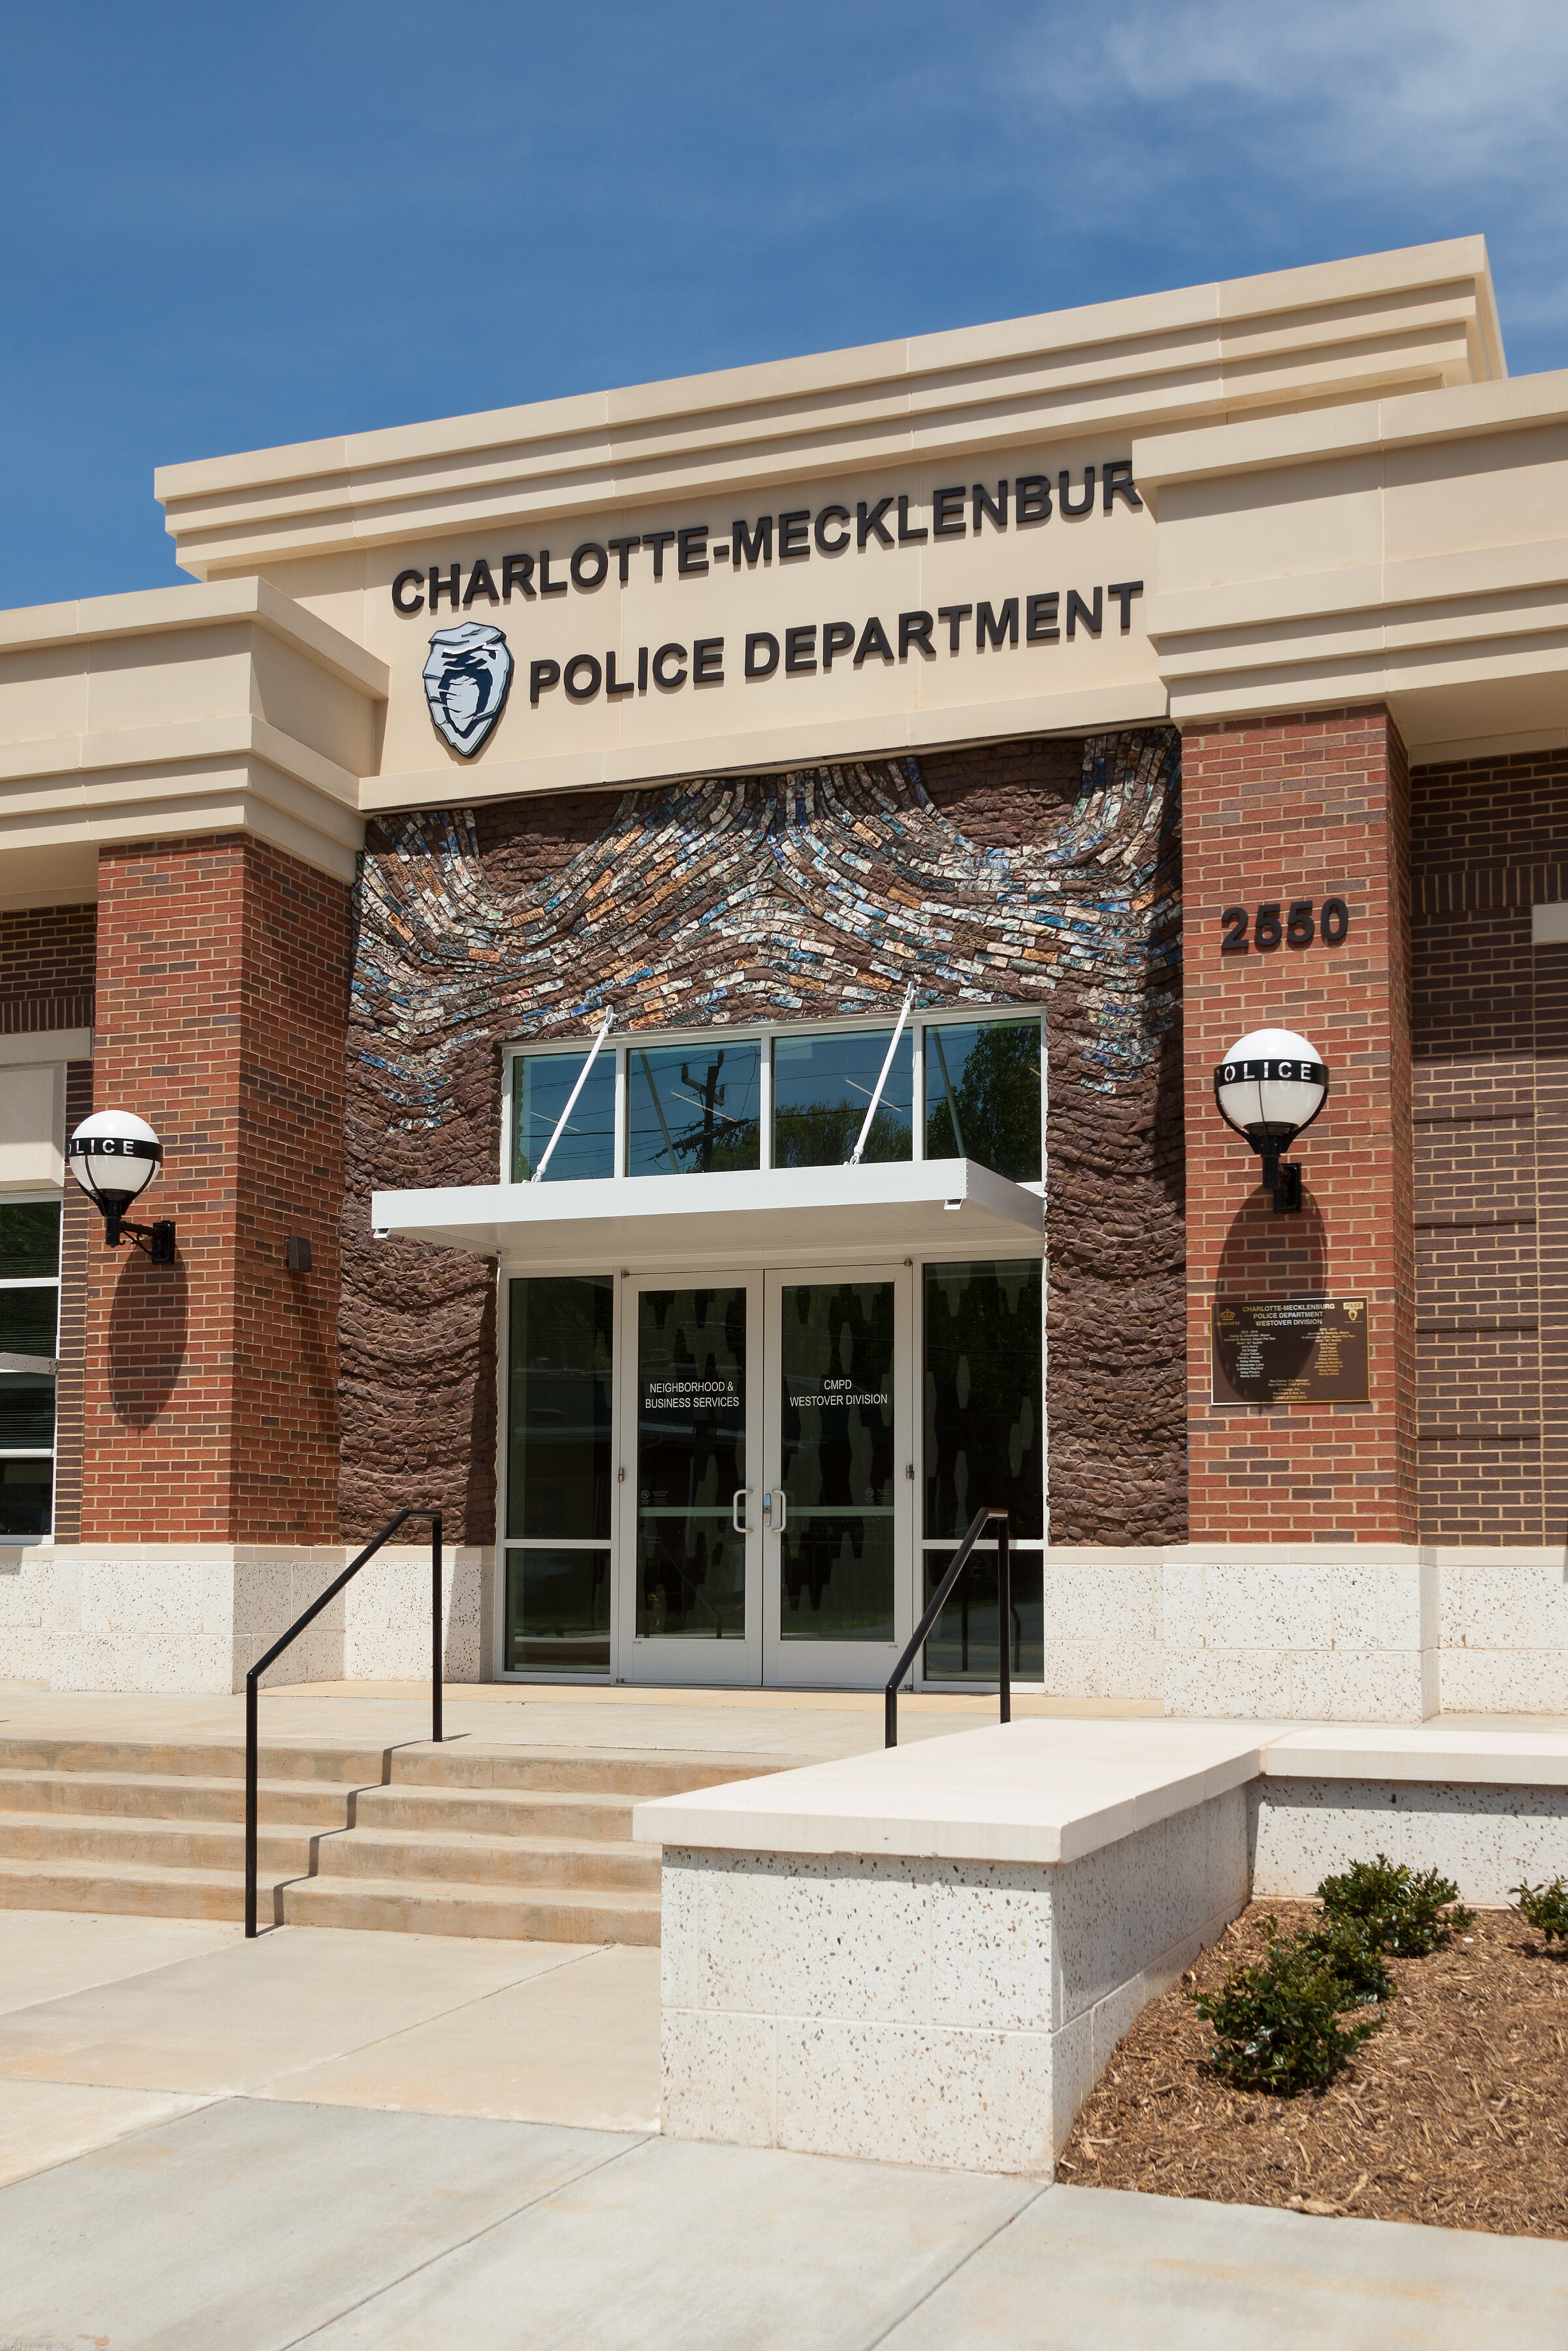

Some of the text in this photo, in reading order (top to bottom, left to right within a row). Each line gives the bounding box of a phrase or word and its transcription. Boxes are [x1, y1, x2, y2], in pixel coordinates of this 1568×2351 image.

[391, 460, 1144, 613] CHARLOTTE-MECKLENBUR
[530, 581, 1144, 703] POLICE DEPARTMENT
[1221, 897, 1349, 948] 2550
[1217, 1061, 1311, 1082] OLICE
[69, 1139, 134, 1155] LICE
[1242, 1303, 1335, 1312] CHARLOTTE-MECKLENBURG
[650, 1381, 734, 1393] NEIGHBORHOOD &
[824, 1379, 852, 1390] CMPD
[645, 1396, 739, 1409] BUSINESS SERVICES
[790, 1394, 888, 1407] WESTOVER DIVISION
